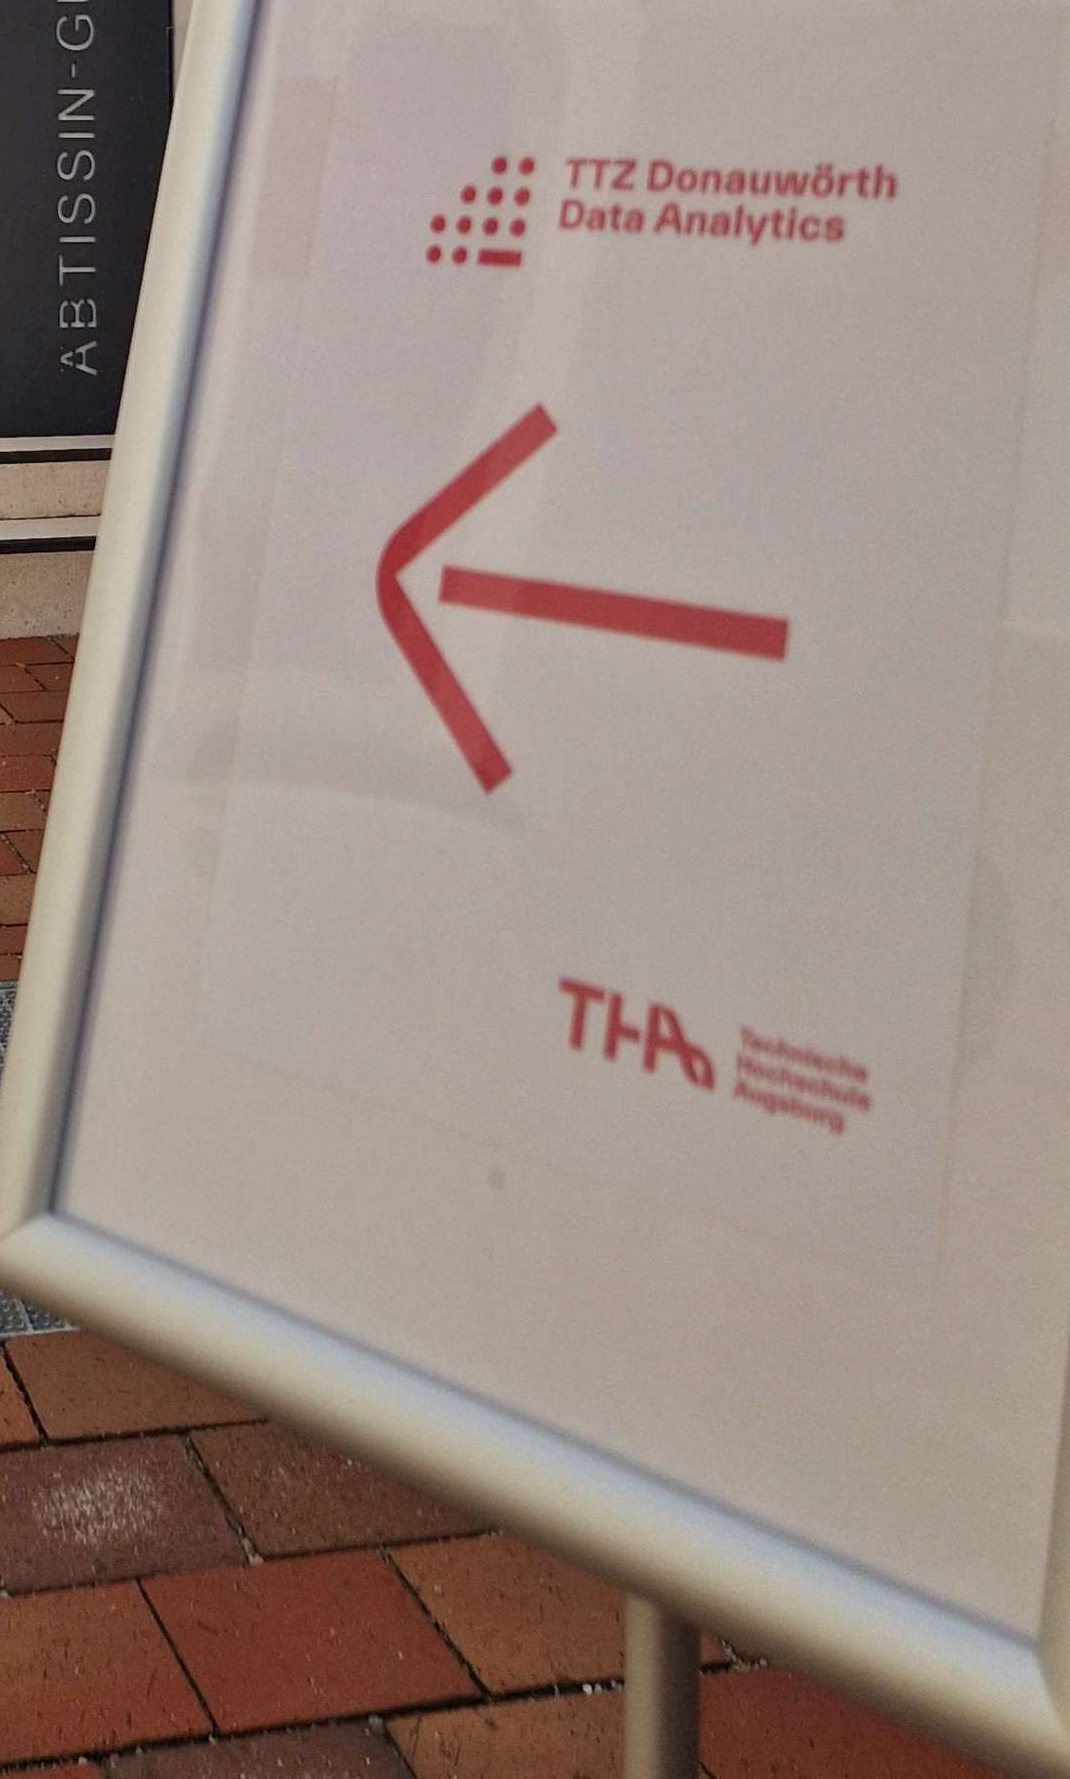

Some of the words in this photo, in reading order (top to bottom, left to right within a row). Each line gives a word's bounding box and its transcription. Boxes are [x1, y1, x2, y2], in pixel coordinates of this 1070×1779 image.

[564, 156, 638, 193] TTZ
[645, 157, 899, 200] Donauwörth
[557, 198, 645, 234] Data
[652, 202, 846, 246] Analytics
